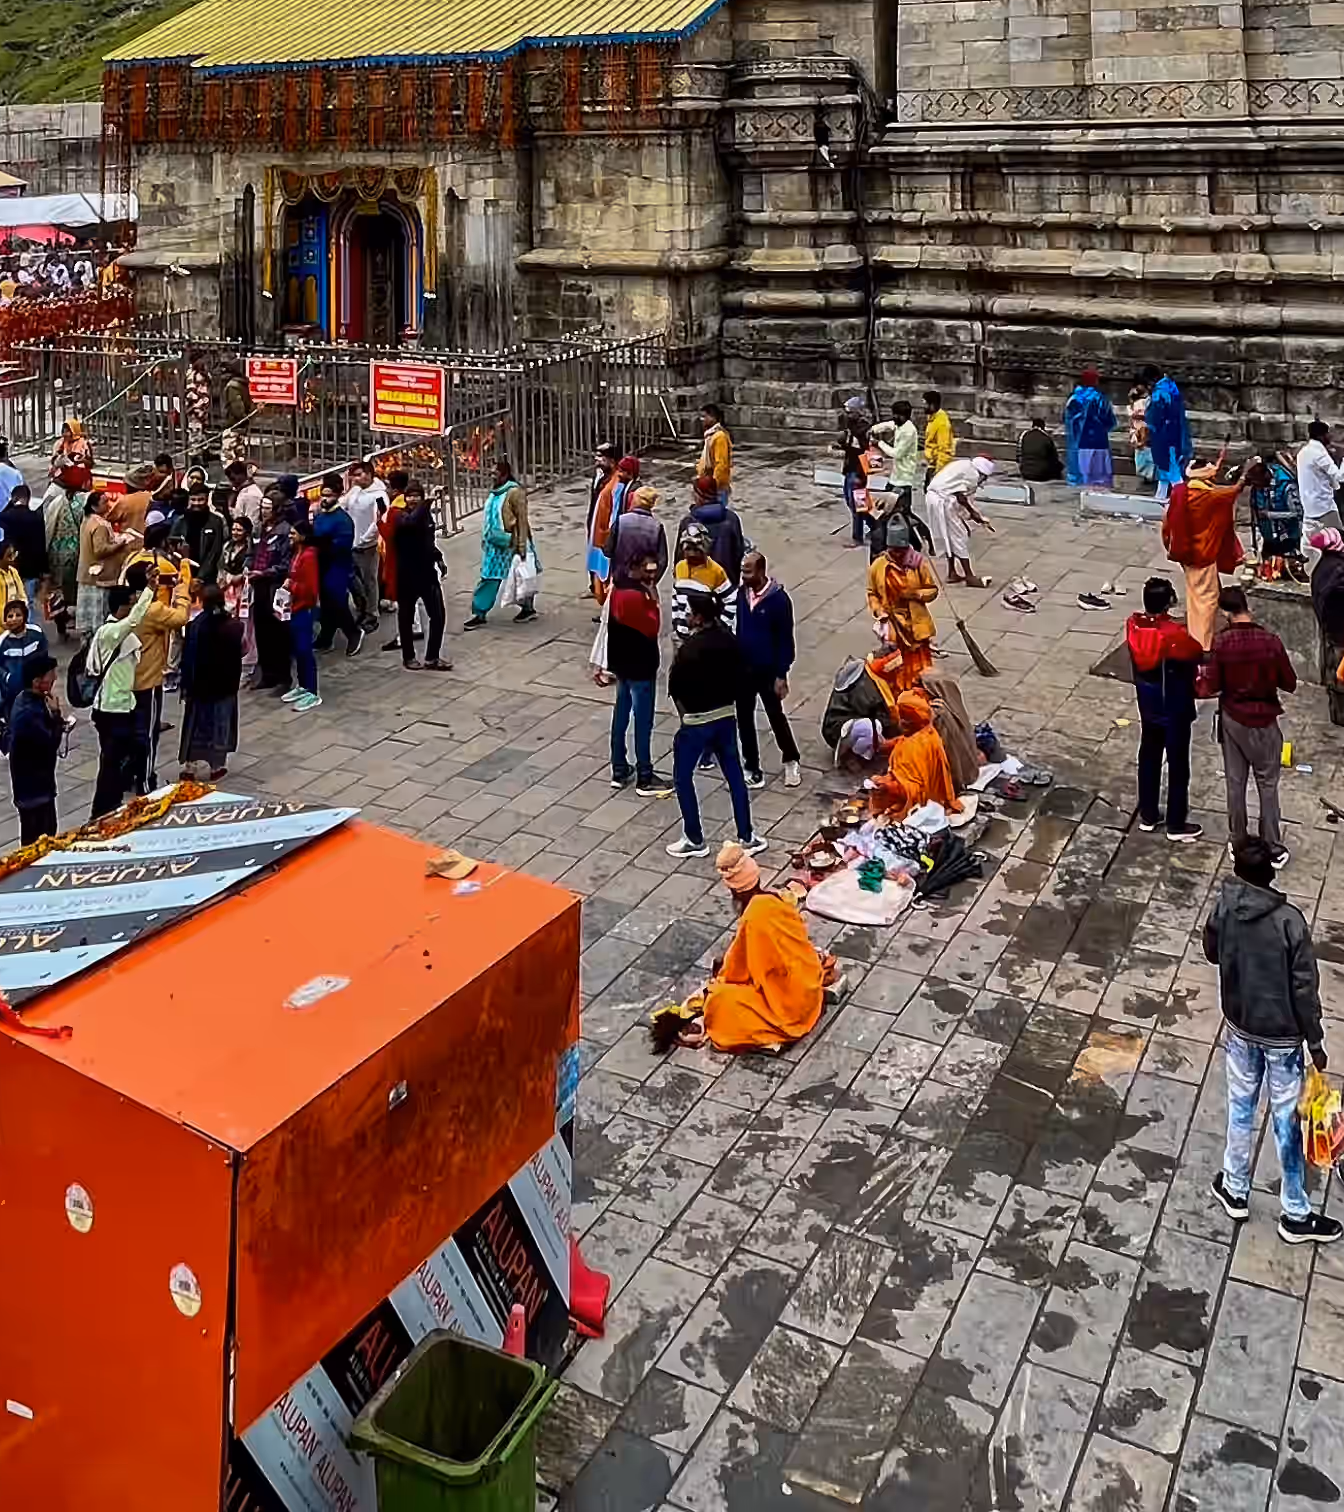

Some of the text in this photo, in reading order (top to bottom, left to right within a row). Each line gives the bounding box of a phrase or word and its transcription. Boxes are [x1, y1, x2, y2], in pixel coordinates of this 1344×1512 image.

[35, 856, 200, 888] ALUPAN
[416, 1260, 454, 1322] ALUPAN
[481, 1201, 543, 1324] ALUPAN
[274, 1392, 320, 1461] ALUPAN
